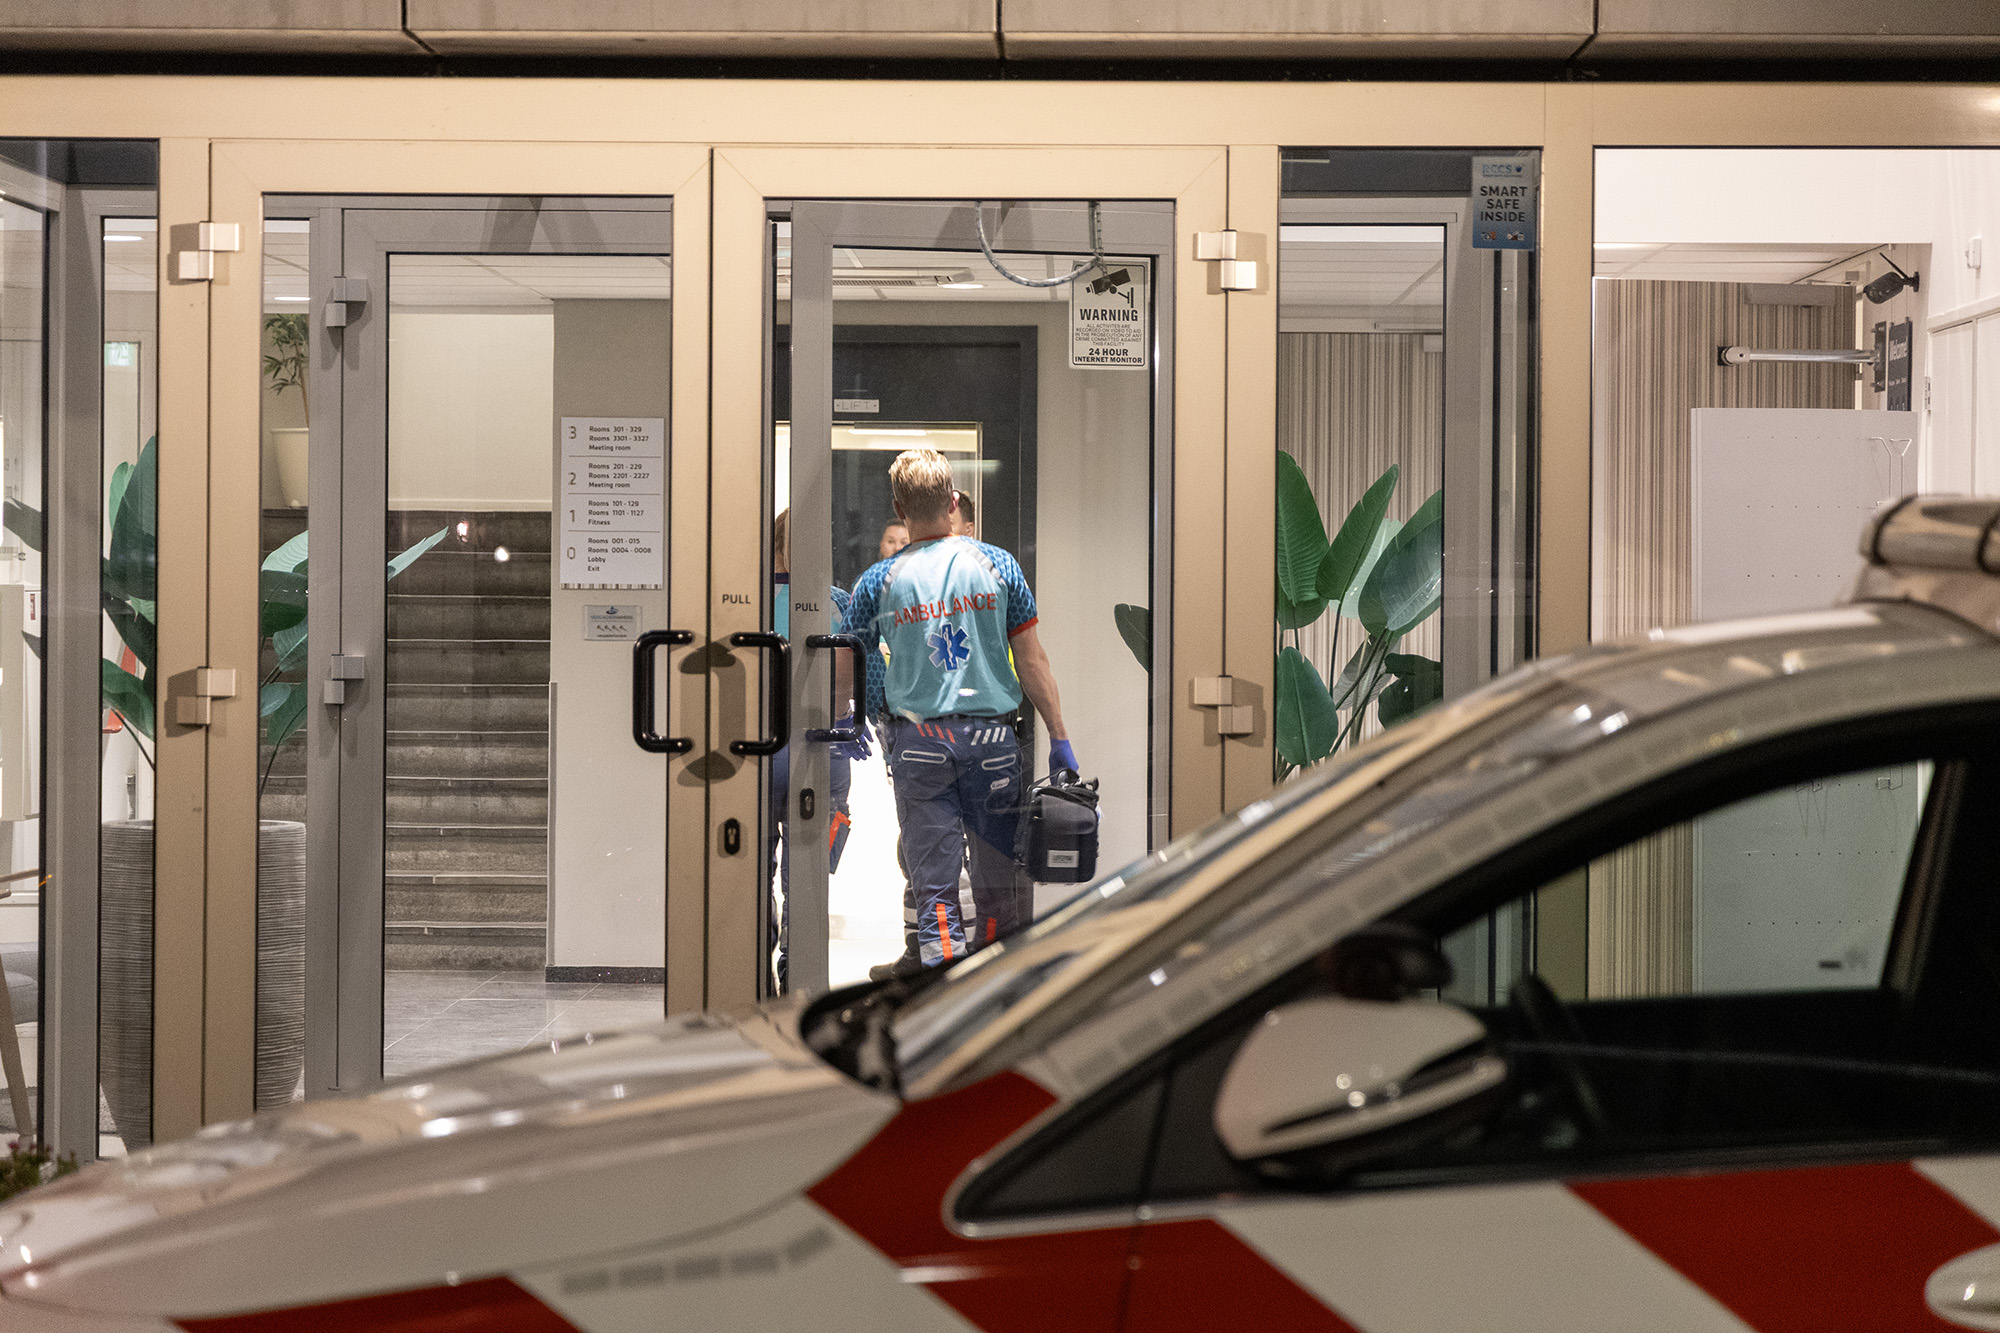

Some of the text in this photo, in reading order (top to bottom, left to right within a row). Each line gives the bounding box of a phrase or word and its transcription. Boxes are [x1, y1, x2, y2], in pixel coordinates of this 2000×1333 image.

[1480, 186, 1527, 196] SMART
[1487, 199, 1519, 209] SAFE
[1480, 212, 1525, 222] INSIDE
[1080, 309, 1138, 321] WARNING
[842, 401, 870, 410] LIFT
[569, 426, 576, 439] 3
[568, 472, 576, 485] 2
[570, 510, 575, 522] 1
[567, 547, 576, 560] 0
[722, 594, 751, 604] PULL
[795, 603, 819, 612] PULL
[894, 593, 997, 627] AMBULANCE
